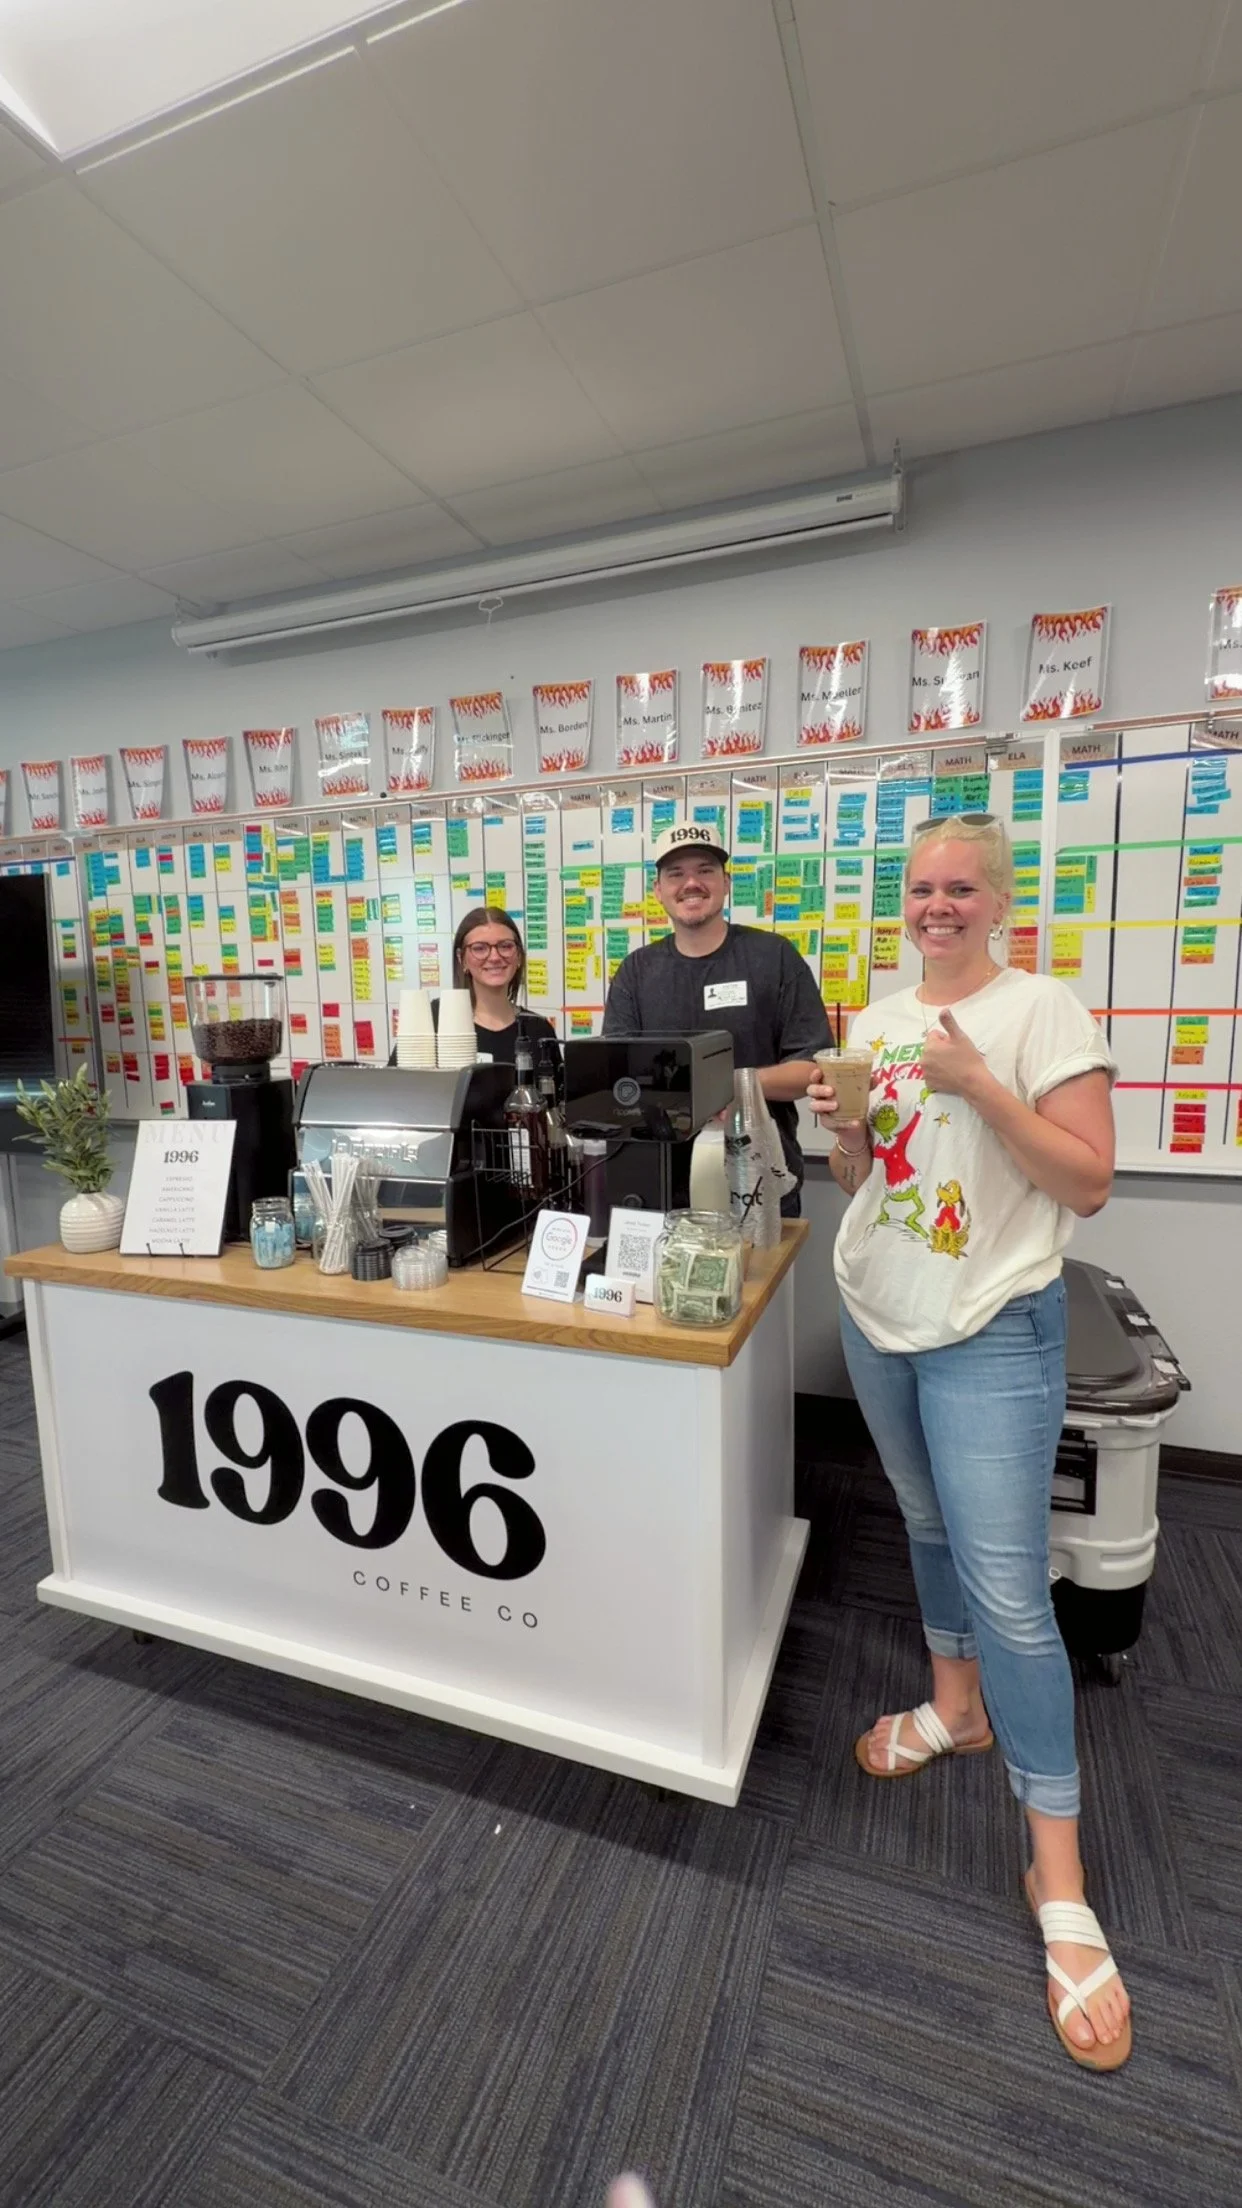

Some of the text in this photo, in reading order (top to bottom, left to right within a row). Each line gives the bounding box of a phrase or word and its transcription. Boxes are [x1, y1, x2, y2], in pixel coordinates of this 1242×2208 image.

[1063, 656, 1092, 671] Keef
[912, 677, 930, 686] Ms.
[726, 701, 763, 714] Bnitez
[624, 712, 673, 726] Ms. Martin
[540, 721, 588, 734] Ms. Borden
[1072, 744, 1101, 754] MATH
[945, 757, 972, 766] MATH
[1008, 753, 1026, 761] ELA
[744, 775, 766, 783] MATH
[653, 785, 674, 794] MATH
[670, 827, 711, 844] 1996
[145, 1122, 229, 1144] MENU
[163, 1150, 200, 1164] 1996
[593, 1287, 623, 1303] 1996
[149, 1370, 547, 1581] 1996
[353, 1570, 539, 1629] COFFEE CO
